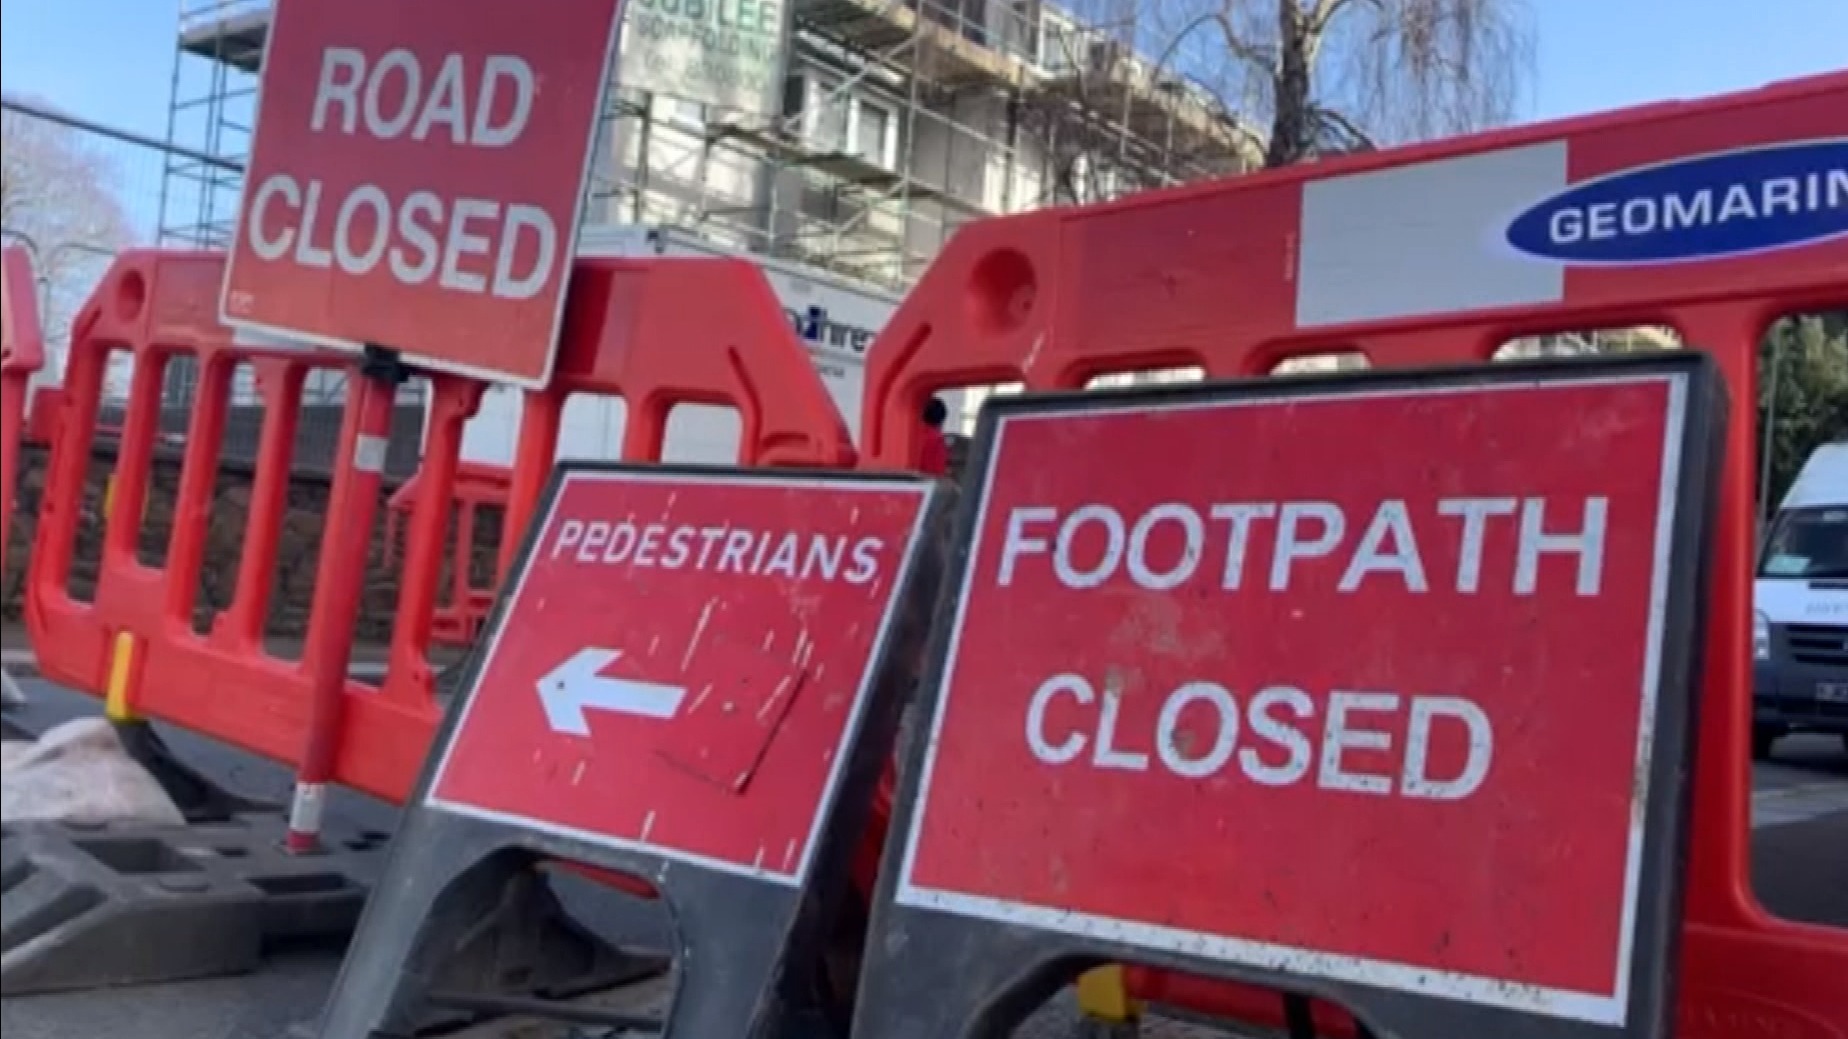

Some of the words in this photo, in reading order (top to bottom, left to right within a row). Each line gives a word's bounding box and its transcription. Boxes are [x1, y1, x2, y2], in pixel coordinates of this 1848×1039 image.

[640, 0, 777, 34] BILEE
[310, 46, 535, 147] ROAD
[248, 173, 557, 300] CLOSED
[551, 519, 884, 584] PEDESTRIANS
[997, 497, 1608, 596] FOOTPATH
[1025, 672, 1493, 800] CLOSED
